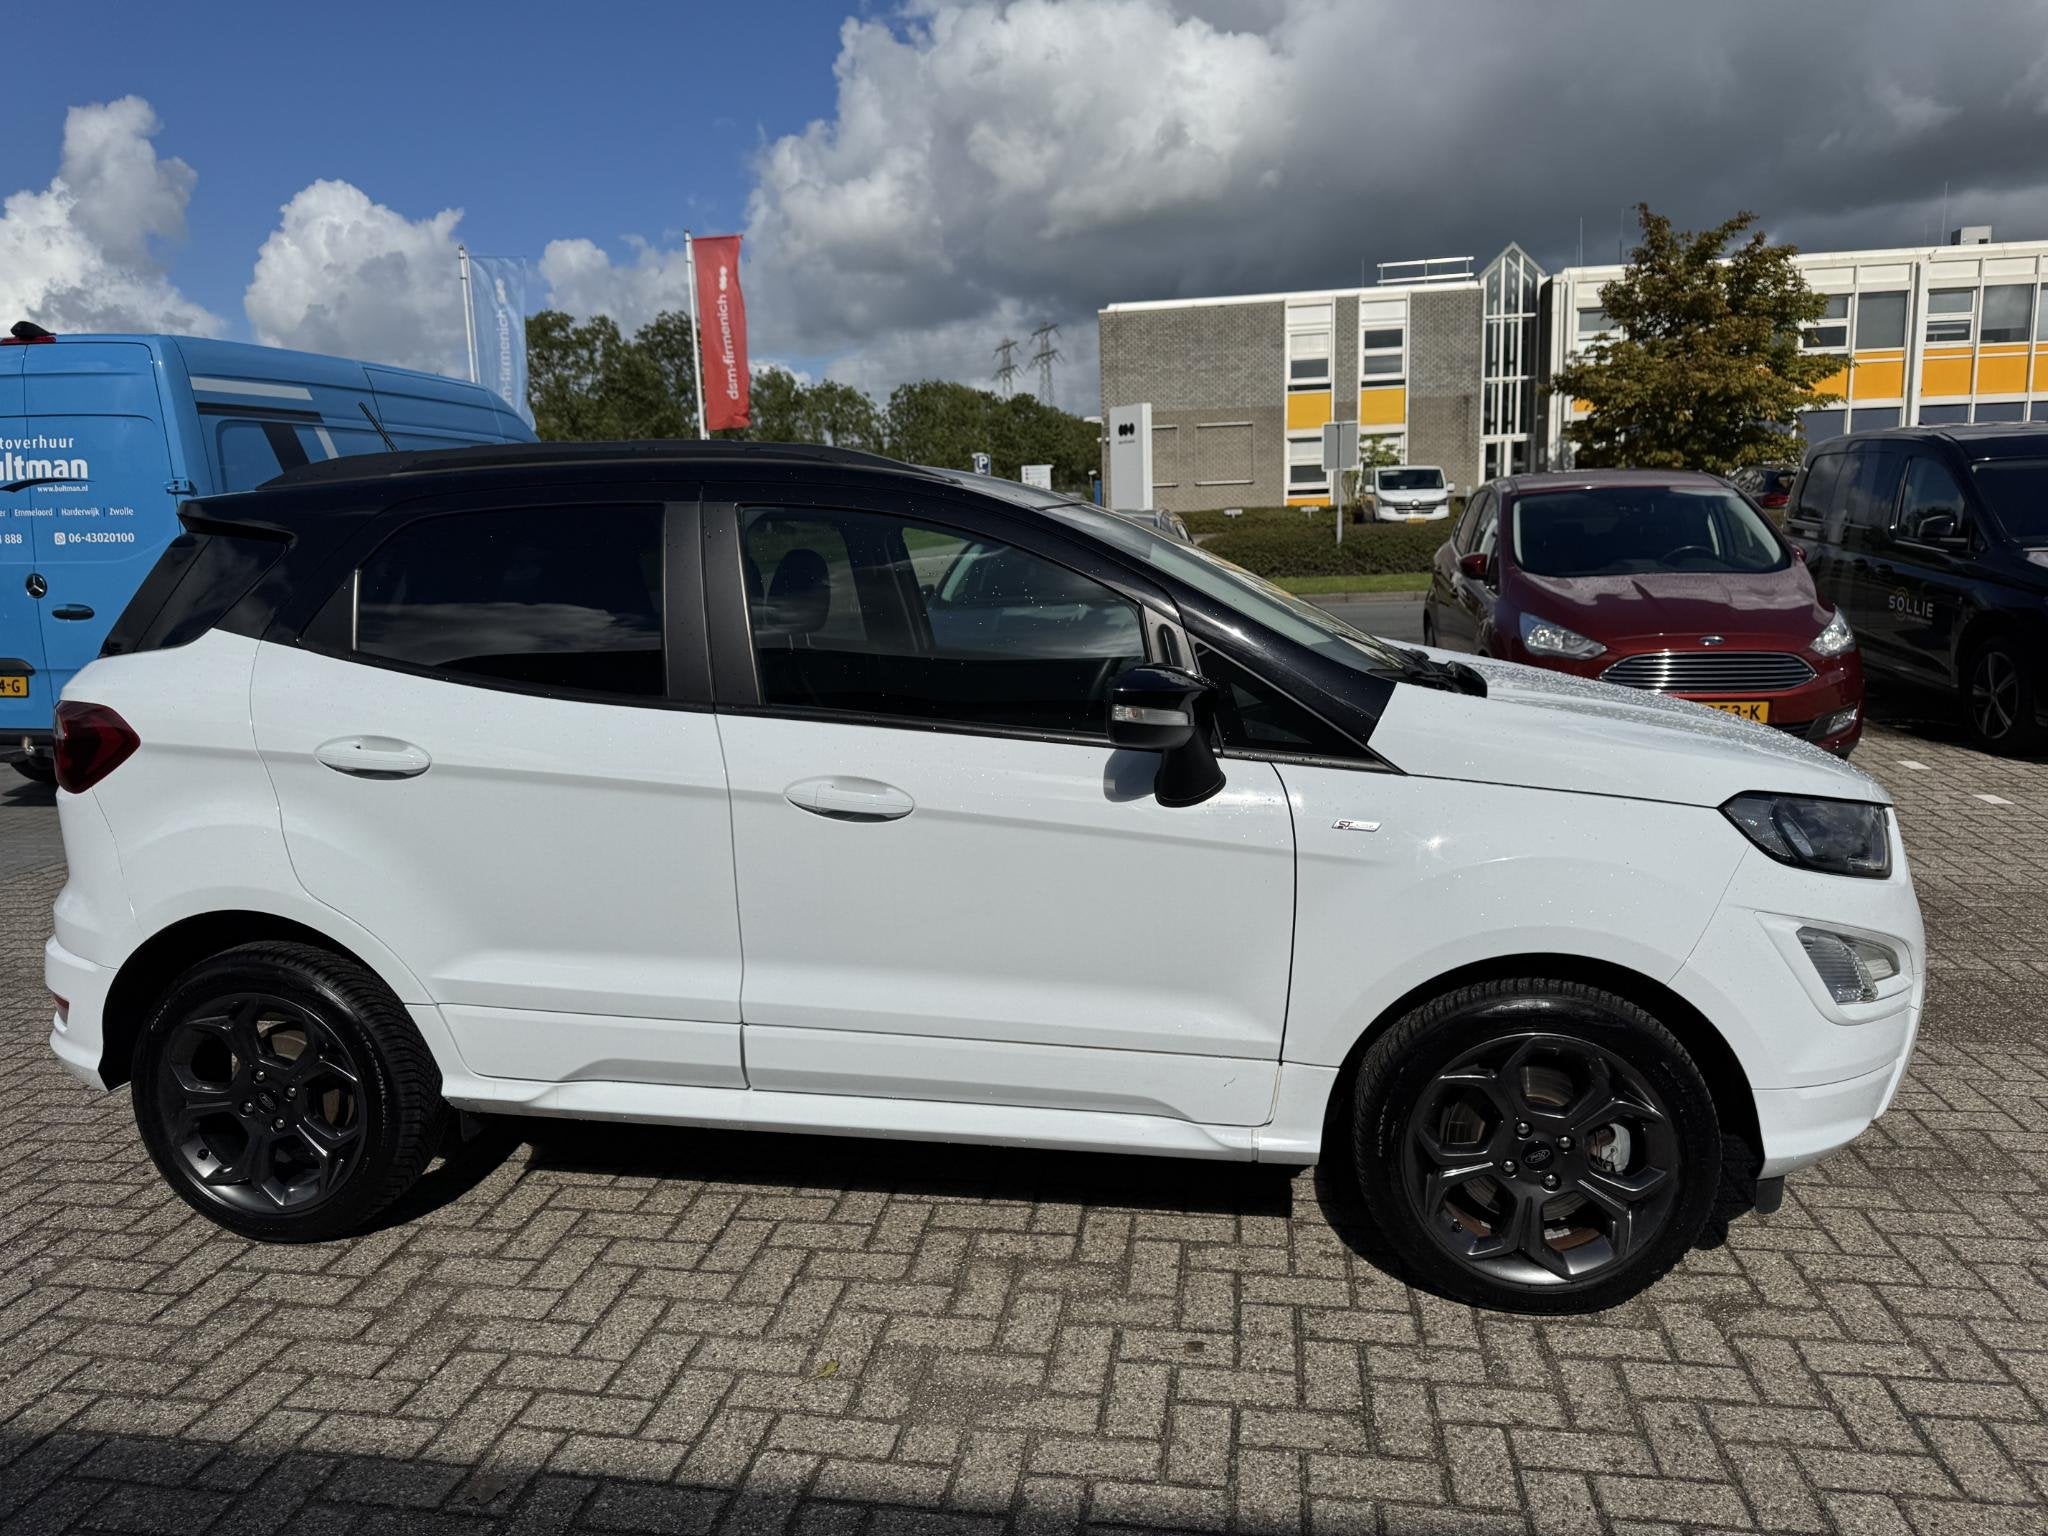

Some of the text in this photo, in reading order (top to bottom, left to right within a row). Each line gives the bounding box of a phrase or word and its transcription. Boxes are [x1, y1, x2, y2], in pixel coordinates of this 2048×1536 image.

[717, 294, 739, 400] dsm-firmenich
[0, 452, 89, 481] ltman
[978, 456, 989, 469] P
[37, 484, 89, 493] www.bultman.nl
[14, 507, 53, 517] Emmeloord
[61, 507, 100, 517] Harderwijk
[109, 507, 134, 517] Zwolle
[68, 532, 135, 543] 06-43020100
[1888, 594, 1935, 619] SOLLIE
